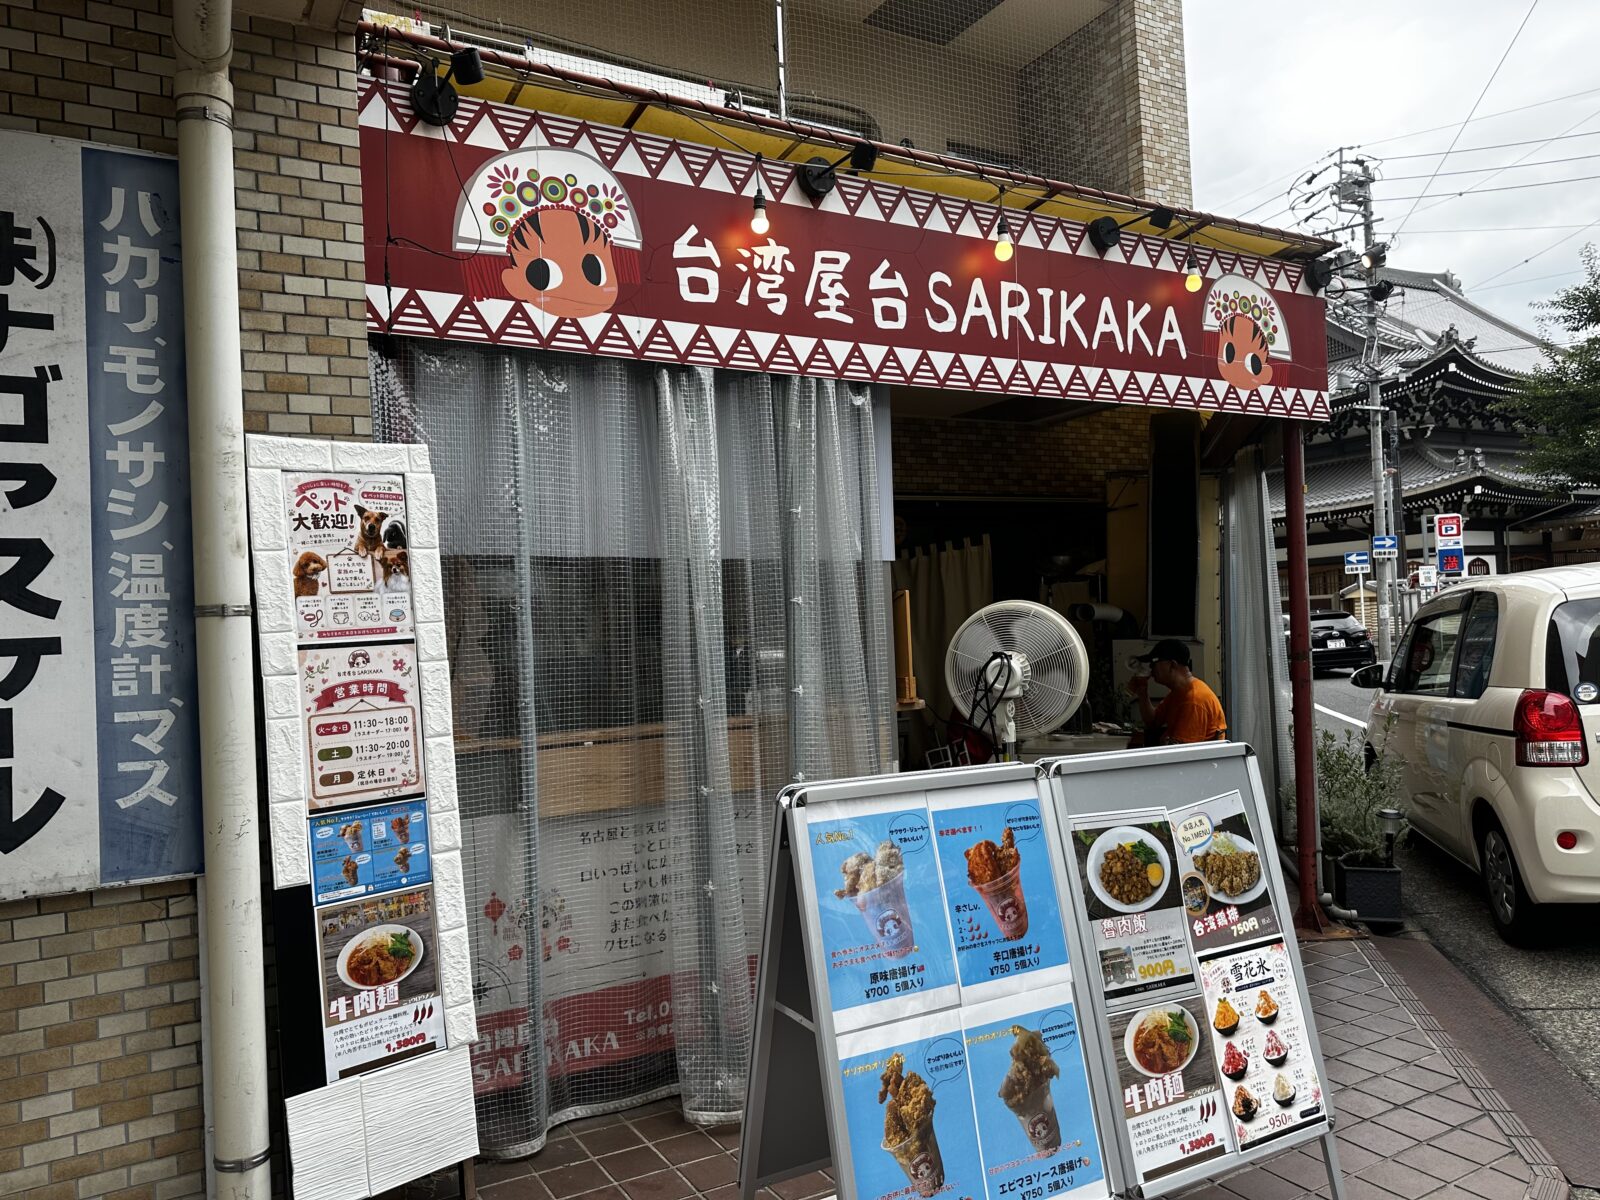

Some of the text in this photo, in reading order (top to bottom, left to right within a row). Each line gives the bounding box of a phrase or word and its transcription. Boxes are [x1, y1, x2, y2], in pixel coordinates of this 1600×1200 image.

[295, 492, 347, 512] ペット
[293, 513, 354, 531] 大歓迎!
[1443, 556, 1459, 570] 満
[334, 682, 388, 699] 営業時間
[331, 749, 340, 759] 土
[333, 768, 385, 783] 月 定休日
[1102, 912, 1148, 940] 魯肉飯
[1230, 916, 1260, 937] 750円
[992, 944, 1032, 962] 辛口唐揚げ
[1015, 957, 1040, 971] 5個入り
[1138, 958, 1176, 979] 900円
[1230, 957, 1272, 983] 雪花氷
[869, 964, 916, 985] 原味唐揚げ
[864, 977, 925, 999] ¥700 5個入り
[329, 982, 400, 1022] 牛肉麺
[1124, 1070, 1185, 1114] 牛肉麺
[999, 1156, 1083, 1195] エビマヨソース唐揚げ
[1047, 1175, 1074, 1193] 5個入り
